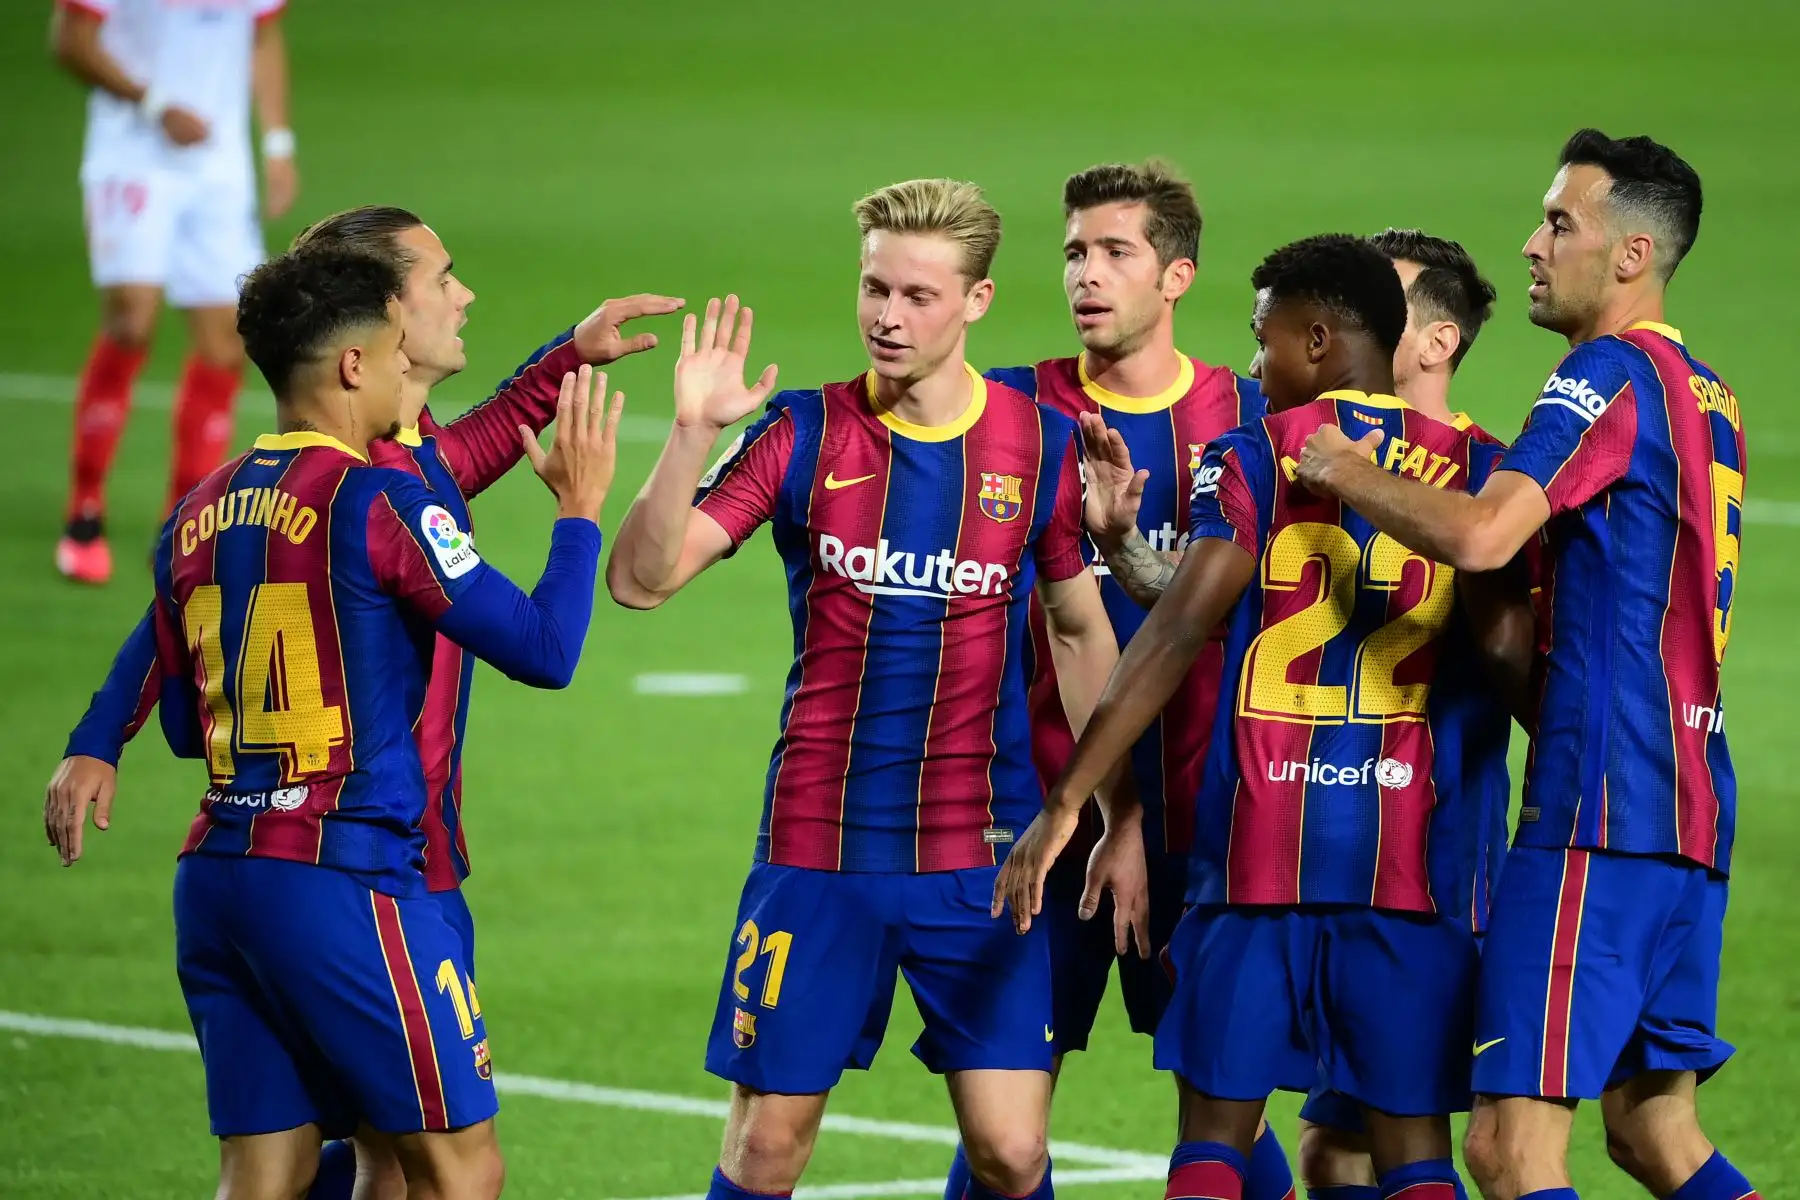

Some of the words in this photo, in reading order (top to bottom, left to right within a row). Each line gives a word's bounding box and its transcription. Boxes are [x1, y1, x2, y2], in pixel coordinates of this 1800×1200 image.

[1543, 373, 1607, 416] beko
[1688, 374, 1740, 432] SERGIO
[1384, 437, 1460, 489] FATI
[180, 487, 318, 556] COUTINHO
[818, 534, 1008, 596] Rakuten
[1708, 460, 1743, 672] 5
[1239, 521, 1456, 725] 22
[184, 582, 345, 784] 14
[1268, 757, 1372, 786] unicef
[733, 919, 793, 1010] 21
